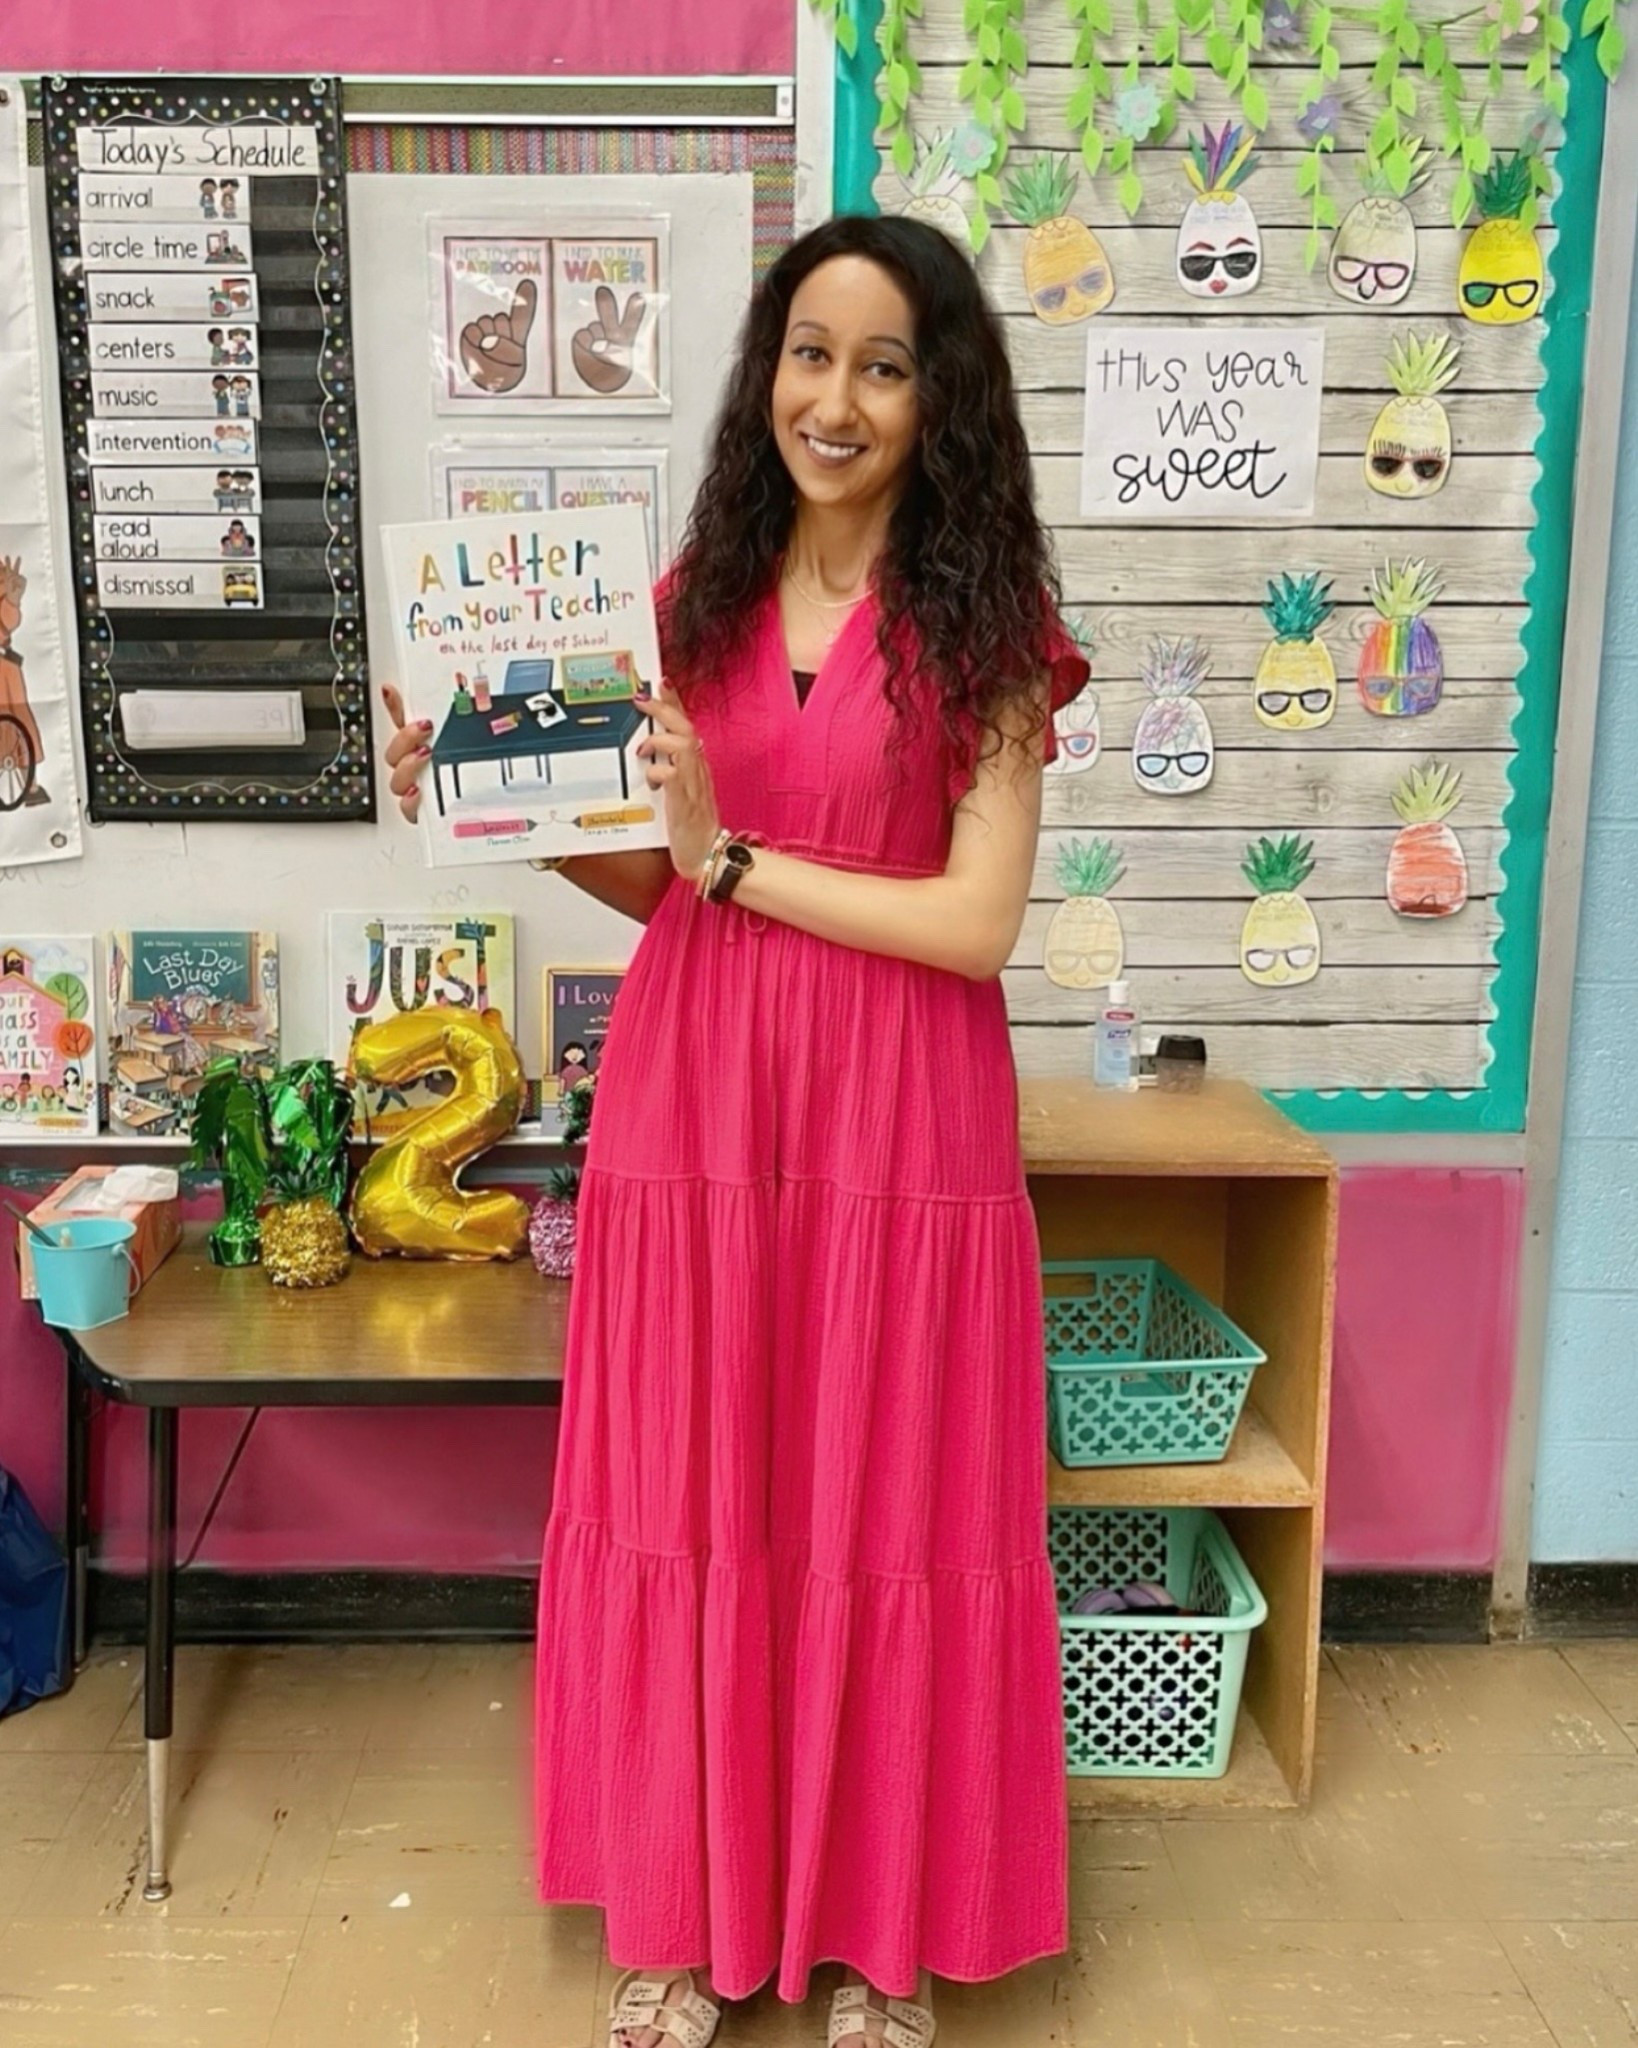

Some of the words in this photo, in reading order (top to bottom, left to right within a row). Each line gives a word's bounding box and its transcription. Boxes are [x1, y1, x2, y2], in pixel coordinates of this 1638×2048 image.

[92, 128, 186, 173] Today's
[196, 127, 307, 168] Schedule
[85, 187, 154, 208] arrival
[87, 236, 144, 260] circle
[154, 236, 198, 259] time
[563, 259, 646, 283] WATER
[95, 286, 155, 309] snack
[95, 336, 175, 359] centers
[1206, 350, 1308, 393] year
[97, 382, 158, 406] music
[1157, 399, 1244, 443] WAS
[93, 432, 212, 452] Intervention
[1112, 440, 1287, 504] sweet
[99, 480, 154, 502] lunch
[461, 490, 544, 512] PENCIL
[560, 491, 650, 508] QUESTION
[101, 518, 151, 537] read
[101, 540, 159, 558] aloud
[420, 553, 446, 595] A
[457, 532, 601, 588] Letter
[104, 575, 194, 595] dismissal
[406, 601, 464, 642] from
[465, 601, 523, 631] your
[524, 578, 635, 622] Teacher
[461, 640, 485, 653] the
[491, 635, 518, 653] last
[526, 634, 547, 653] day
[553, 636, 567, 650] of
[143, 951, 194, 975] Last
[199, 948, 245, 975] Day
[346, 918, 496, 1013] JUST
[164, 967, 223, 990] Blues
[559, 986, 565, 1005] I
[574, 985, 614, 1005] Lov
[17, 1035, 27, 1048] a
[0, 1050, 52, 1071] AMILY
